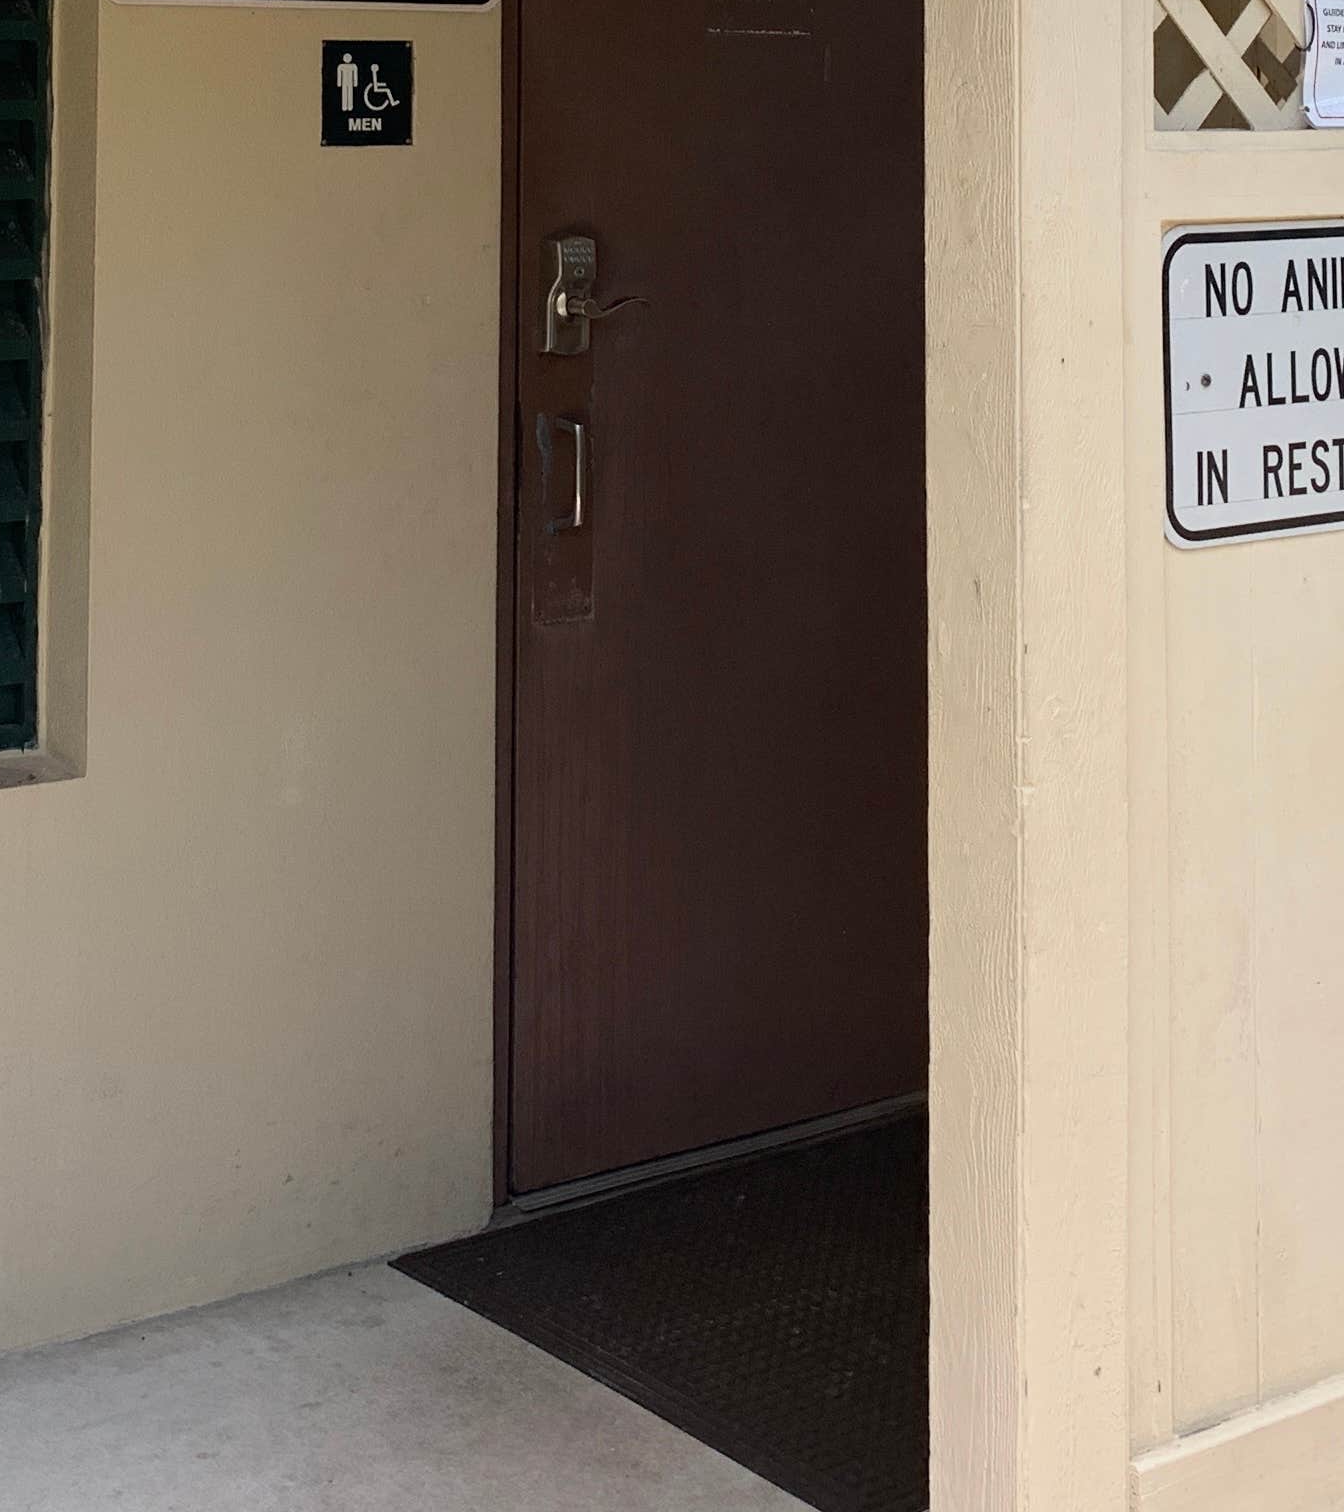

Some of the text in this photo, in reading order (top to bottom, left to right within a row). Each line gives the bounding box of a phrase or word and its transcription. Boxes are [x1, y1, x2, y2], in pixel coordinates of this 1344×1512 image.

[1326, 24, 1341, 34] STAY
[1321, 40, 1335, 50] AND
[1335, 58, 1343, 67] IN
[348, 117, 382, 131] MEN
[1204, 261, 1253, 317] NO
[1197, 449, 1229, 506] IN
